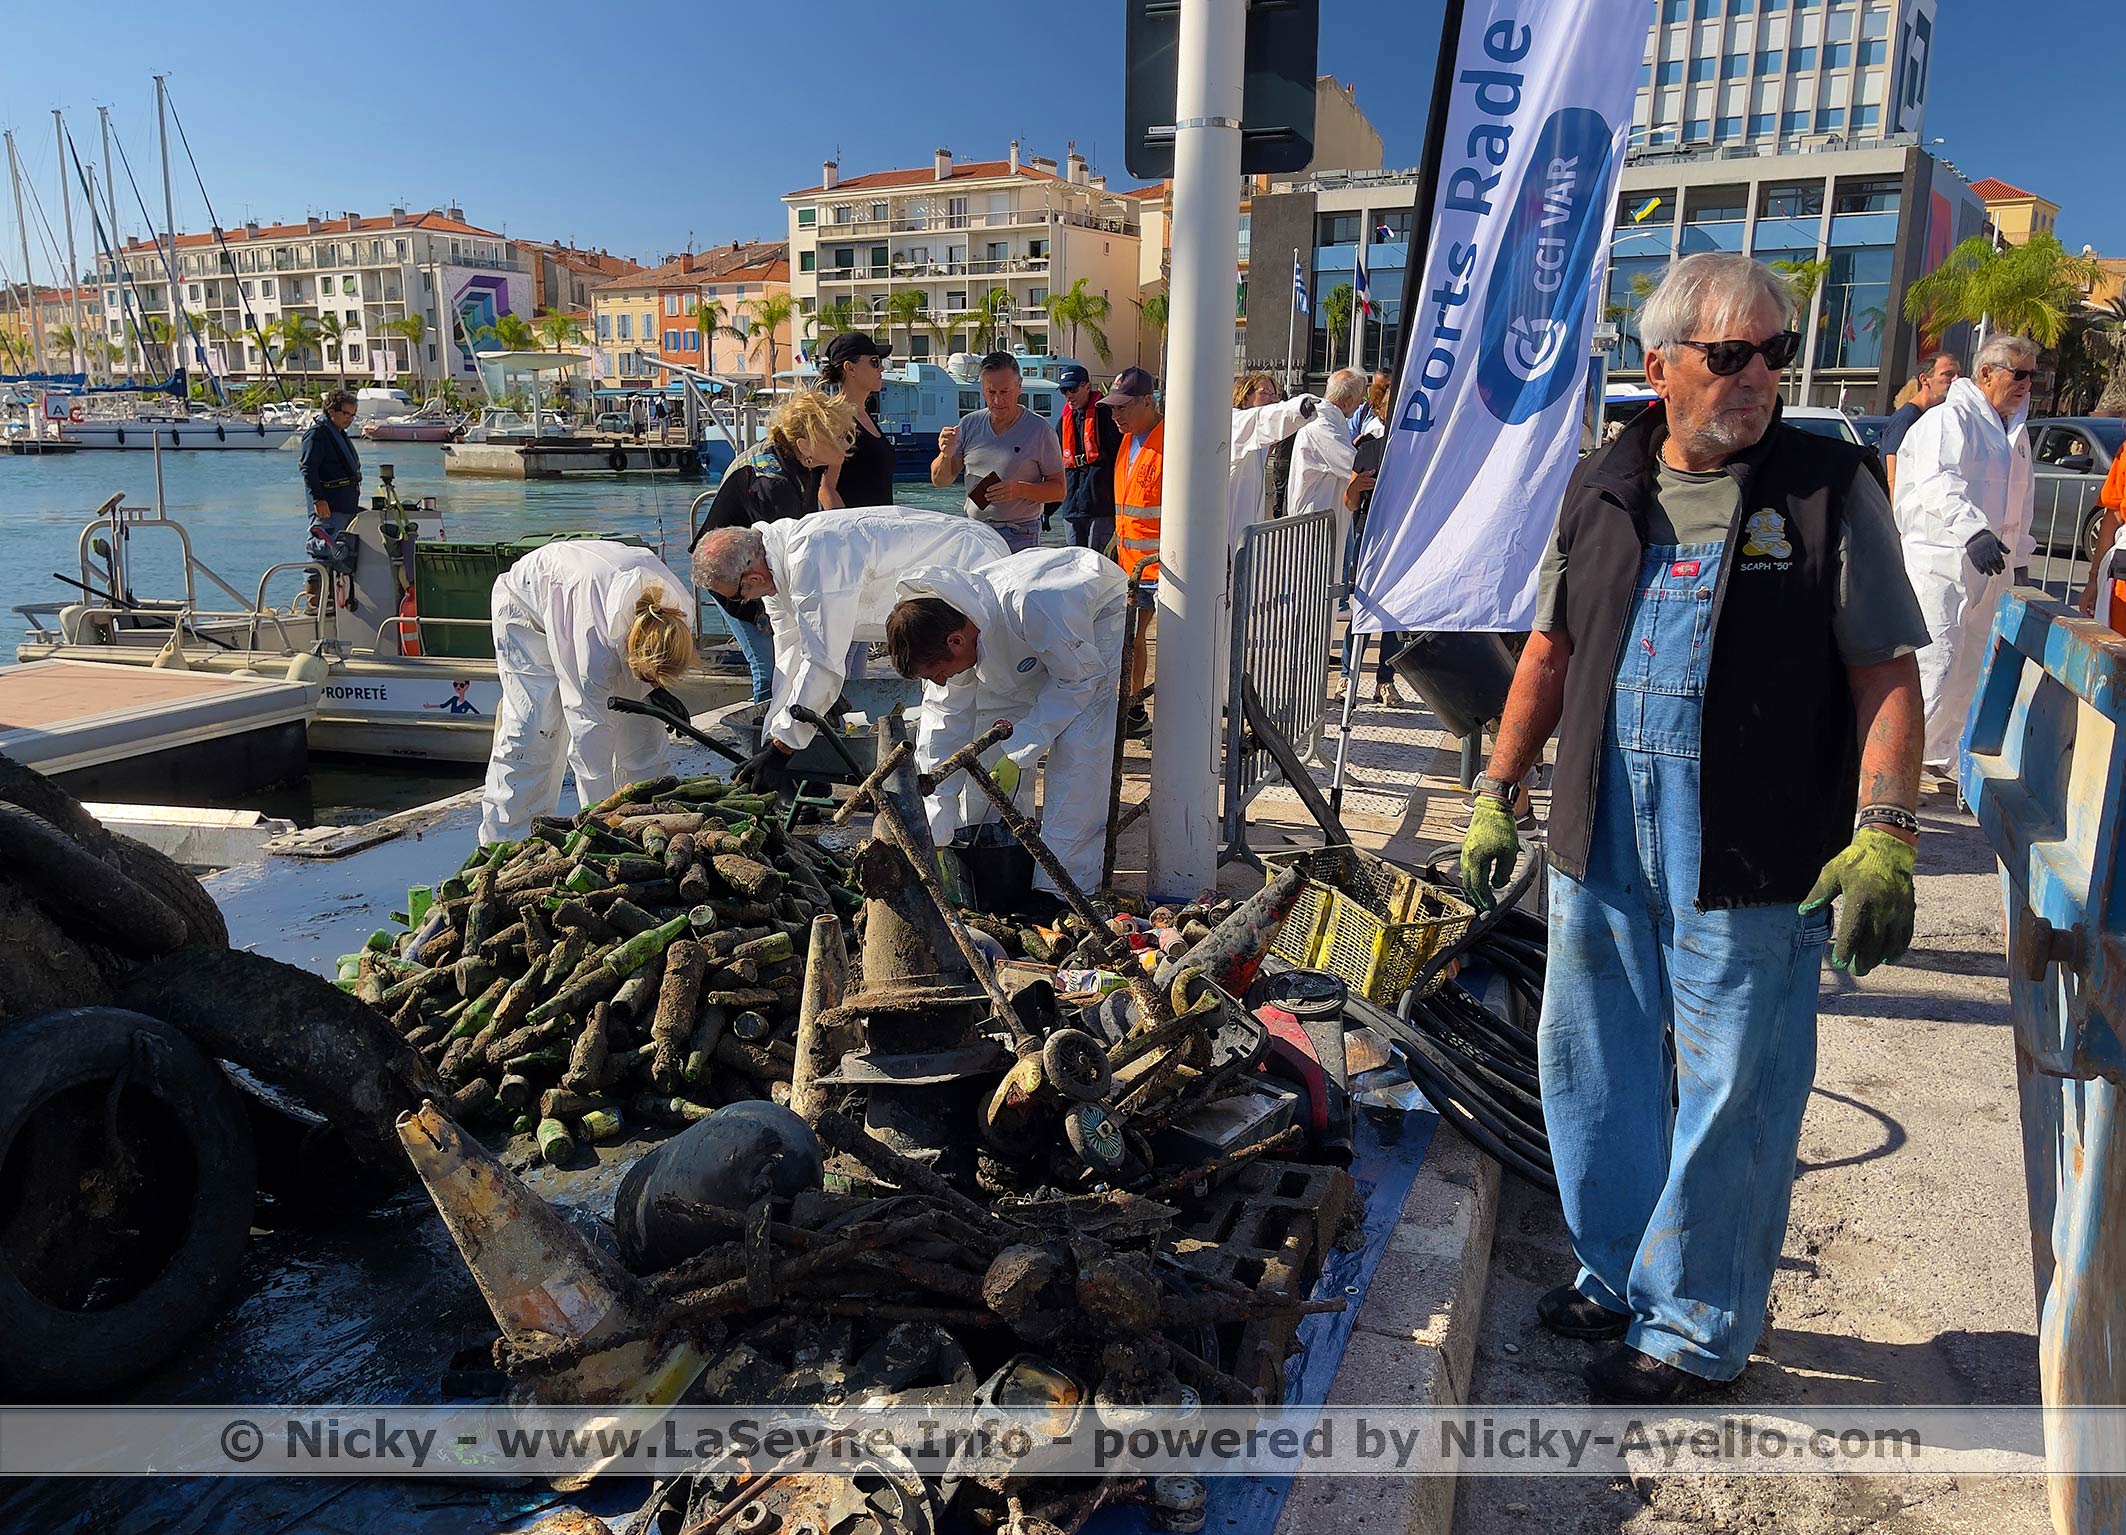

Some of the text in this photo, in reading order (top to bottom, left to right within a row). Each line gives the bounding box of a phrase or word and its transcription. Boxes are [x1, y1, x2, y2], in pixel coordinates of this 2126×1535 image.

[1399, 19, 1532, 432] Ports Rade
[1533, 154, 1579, 293] CCI VAR
[53, 404, 65, 416] A
[1740, 562, 1772, 572] SCAPH
